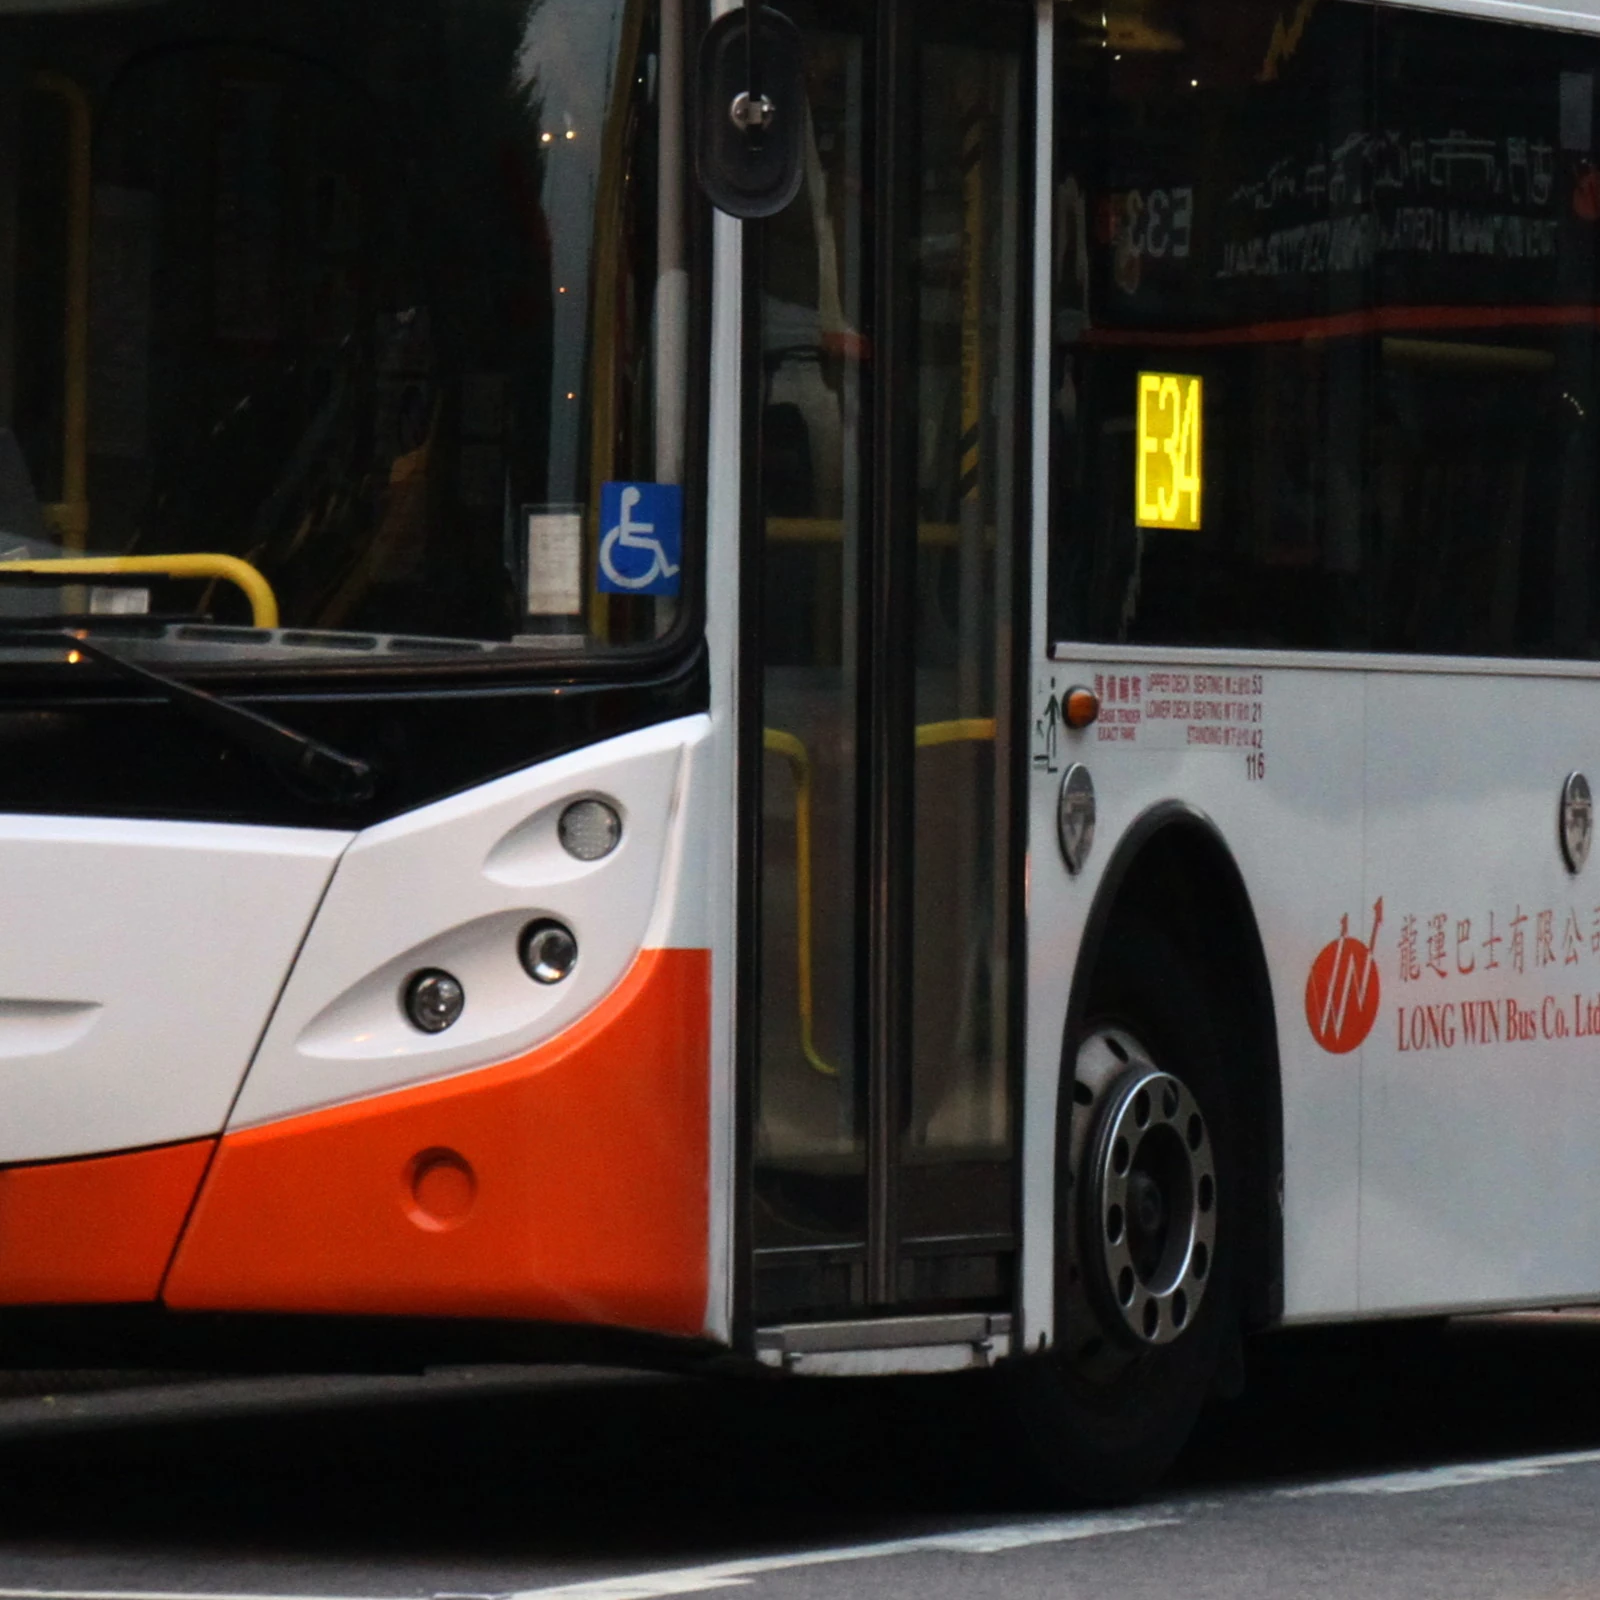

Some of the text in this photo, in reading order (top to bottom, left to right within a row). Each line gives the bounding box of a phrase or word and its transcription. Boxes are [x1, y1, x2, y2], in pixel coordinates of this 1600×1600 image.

[1139, 375, 1200, 523] E34
[1245, 752, 1265, 781] 116
[1397, 1002, 1455, 1052] LONG
[1460, 998, 1502, 1046] WIN
[1505, 998, 1536, 1042] Bus
[1541, 995, 1570, 1040] Co.
